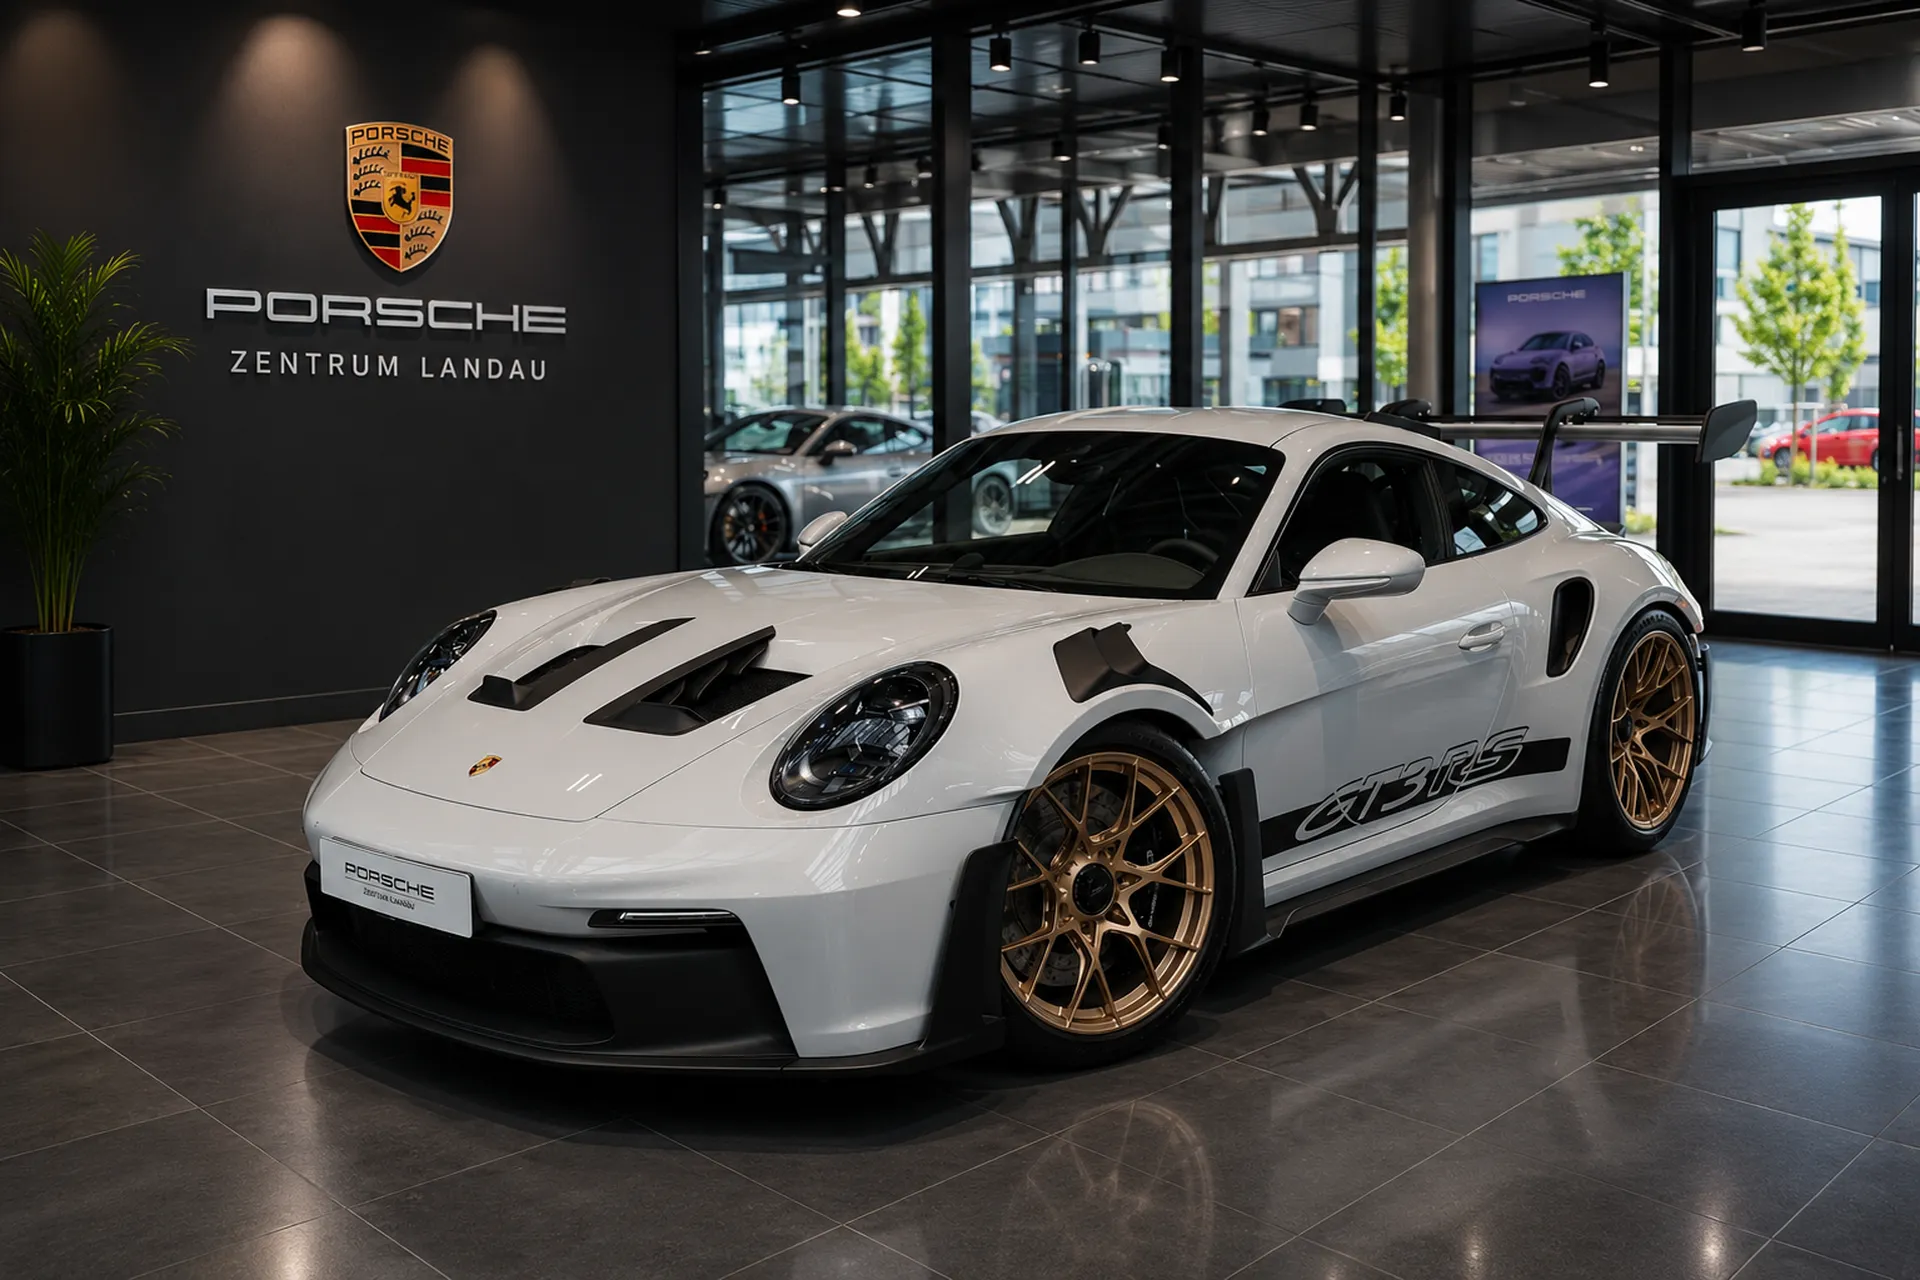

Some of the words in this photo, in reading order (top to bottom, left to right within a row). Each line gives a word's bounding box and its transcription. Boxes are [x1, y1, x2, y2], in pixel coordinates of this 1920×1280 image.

[352, 126, 449, 154] PORSCHE
[206, 288, 566, 334] PORSCHE
[1508, 290, 1586, 303] PORSCHE
[230, 350, 399, 377] ZENTRUM
[421, 356, 547, 381] LANDAU
[345, 862, 434, 900] PORSCHE
